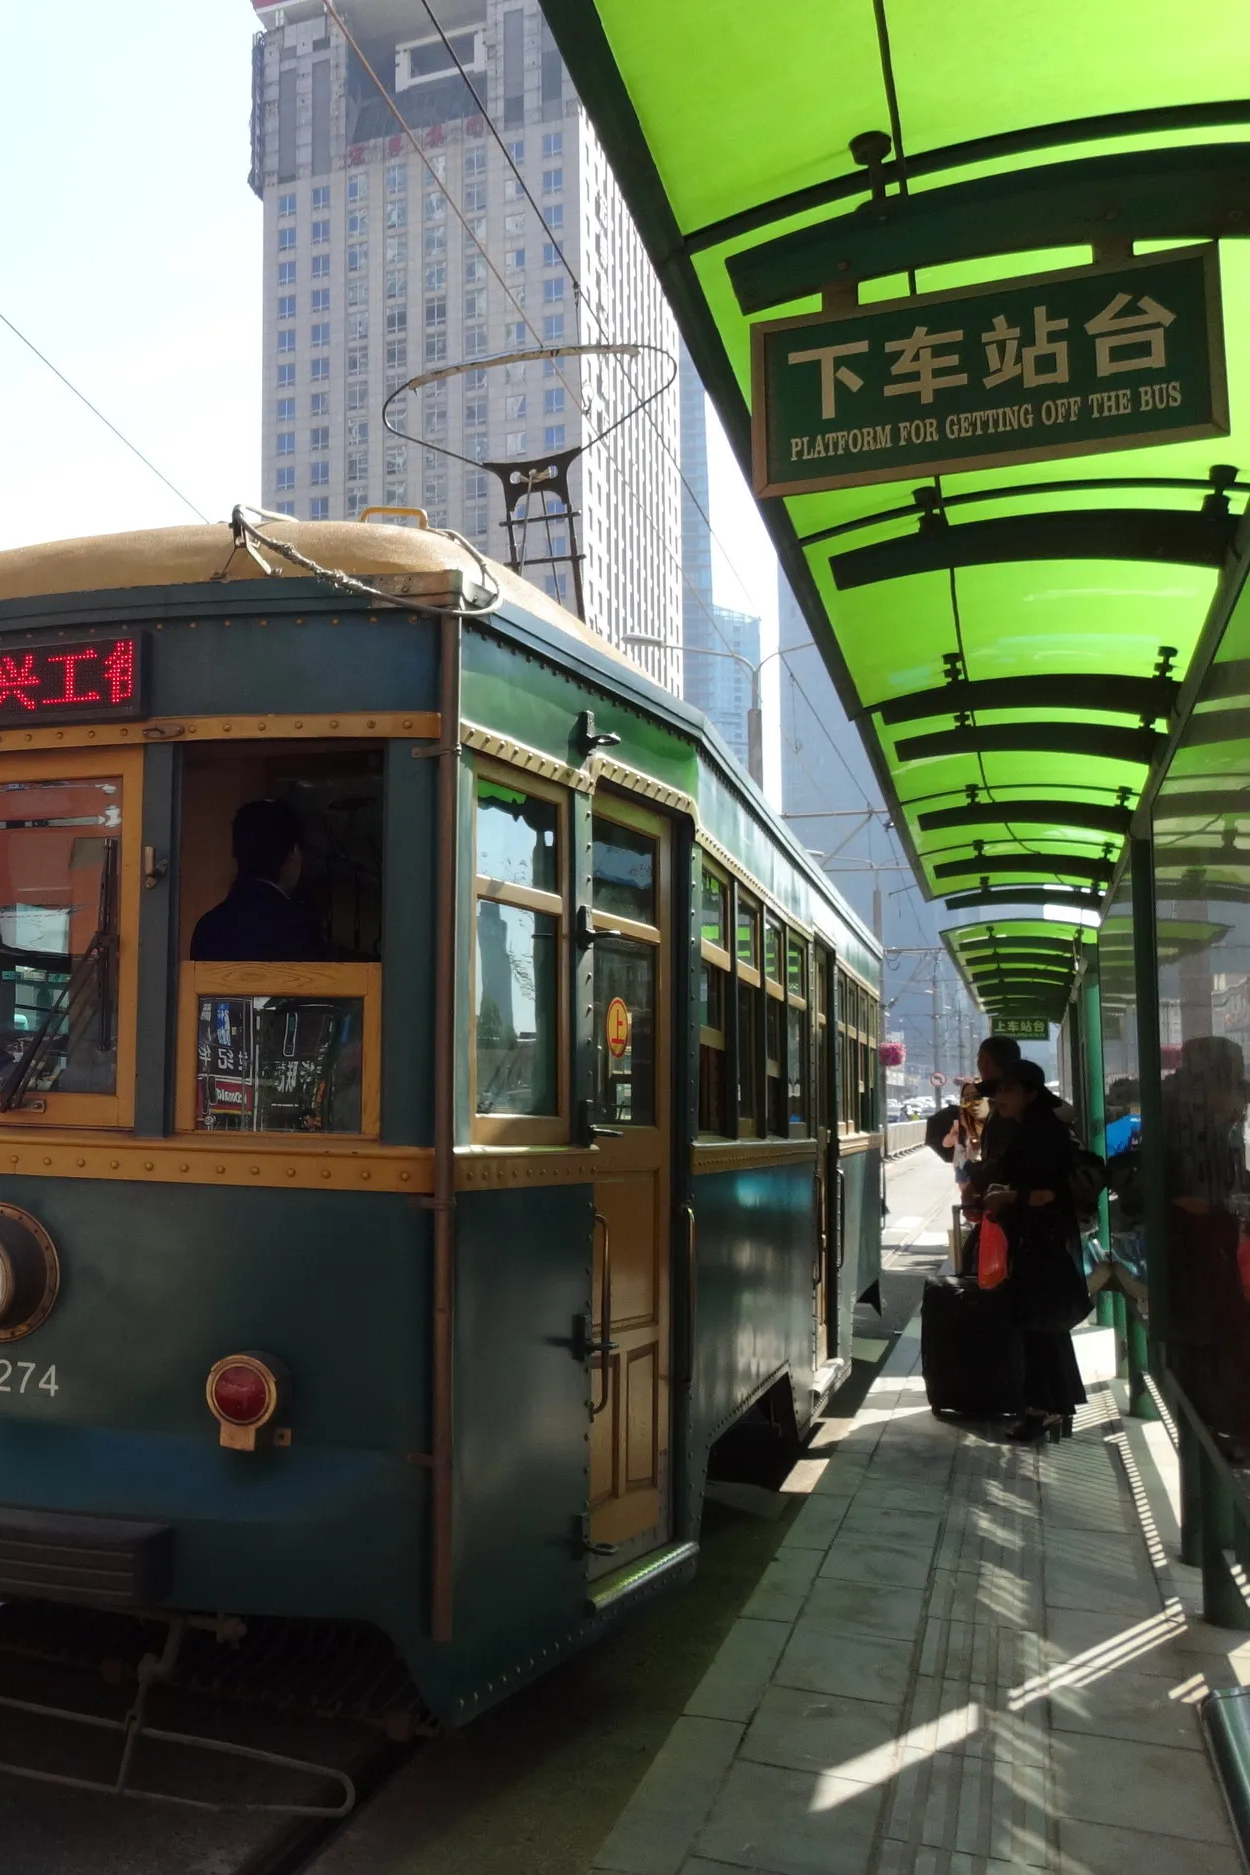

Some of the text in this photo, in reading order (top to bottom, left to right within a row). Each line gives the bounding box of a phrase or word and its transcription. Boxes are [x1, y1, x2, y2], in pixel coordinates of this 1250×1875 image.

[787, 292, 1177, 420] 下车站台
[790, 381, 1182, 462] PLATFORM FOR GETTING OFF THE BUS
[611, 1008, 625, 1045] 上
[994, 1020, 1045, 1033] 上车站台
